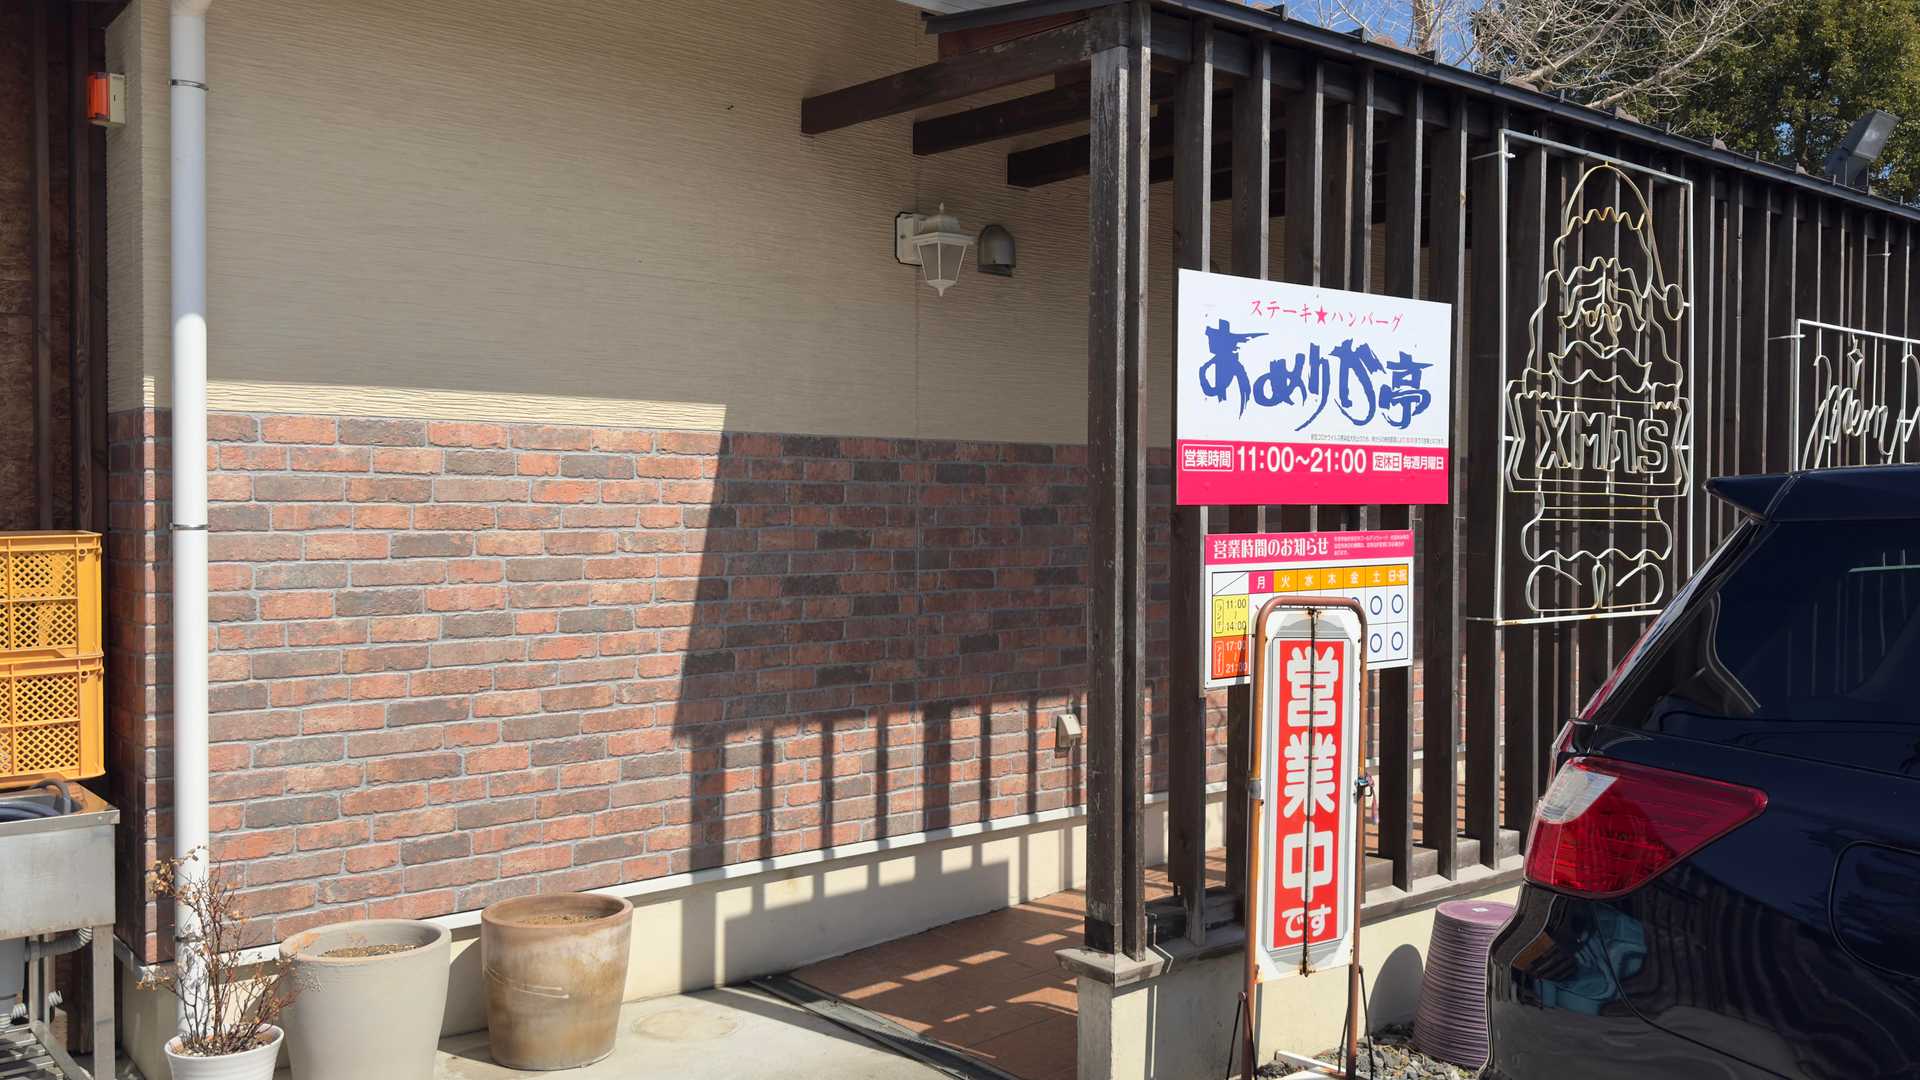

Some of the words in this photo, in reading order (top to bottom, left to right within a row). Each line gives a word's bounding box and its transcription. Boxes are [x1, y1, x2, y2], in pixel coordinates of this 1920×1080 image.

[1535, 409, 1669, 475] XMAS
[1184, 449, 1231, 469] 営業時間
[1374, 454, 1400, 469] 定休日
[1403, 455, 1444, 470] 毎週月曜日
[1213, 537, 1329, 560] 営業時間のお知らせ
[1257, 576, 1266, 590] 月
[1280, 575, 1291, 588] 火
[1350, 571, 1359, 584] 金
[1373, 571, 1382, 583] 土
